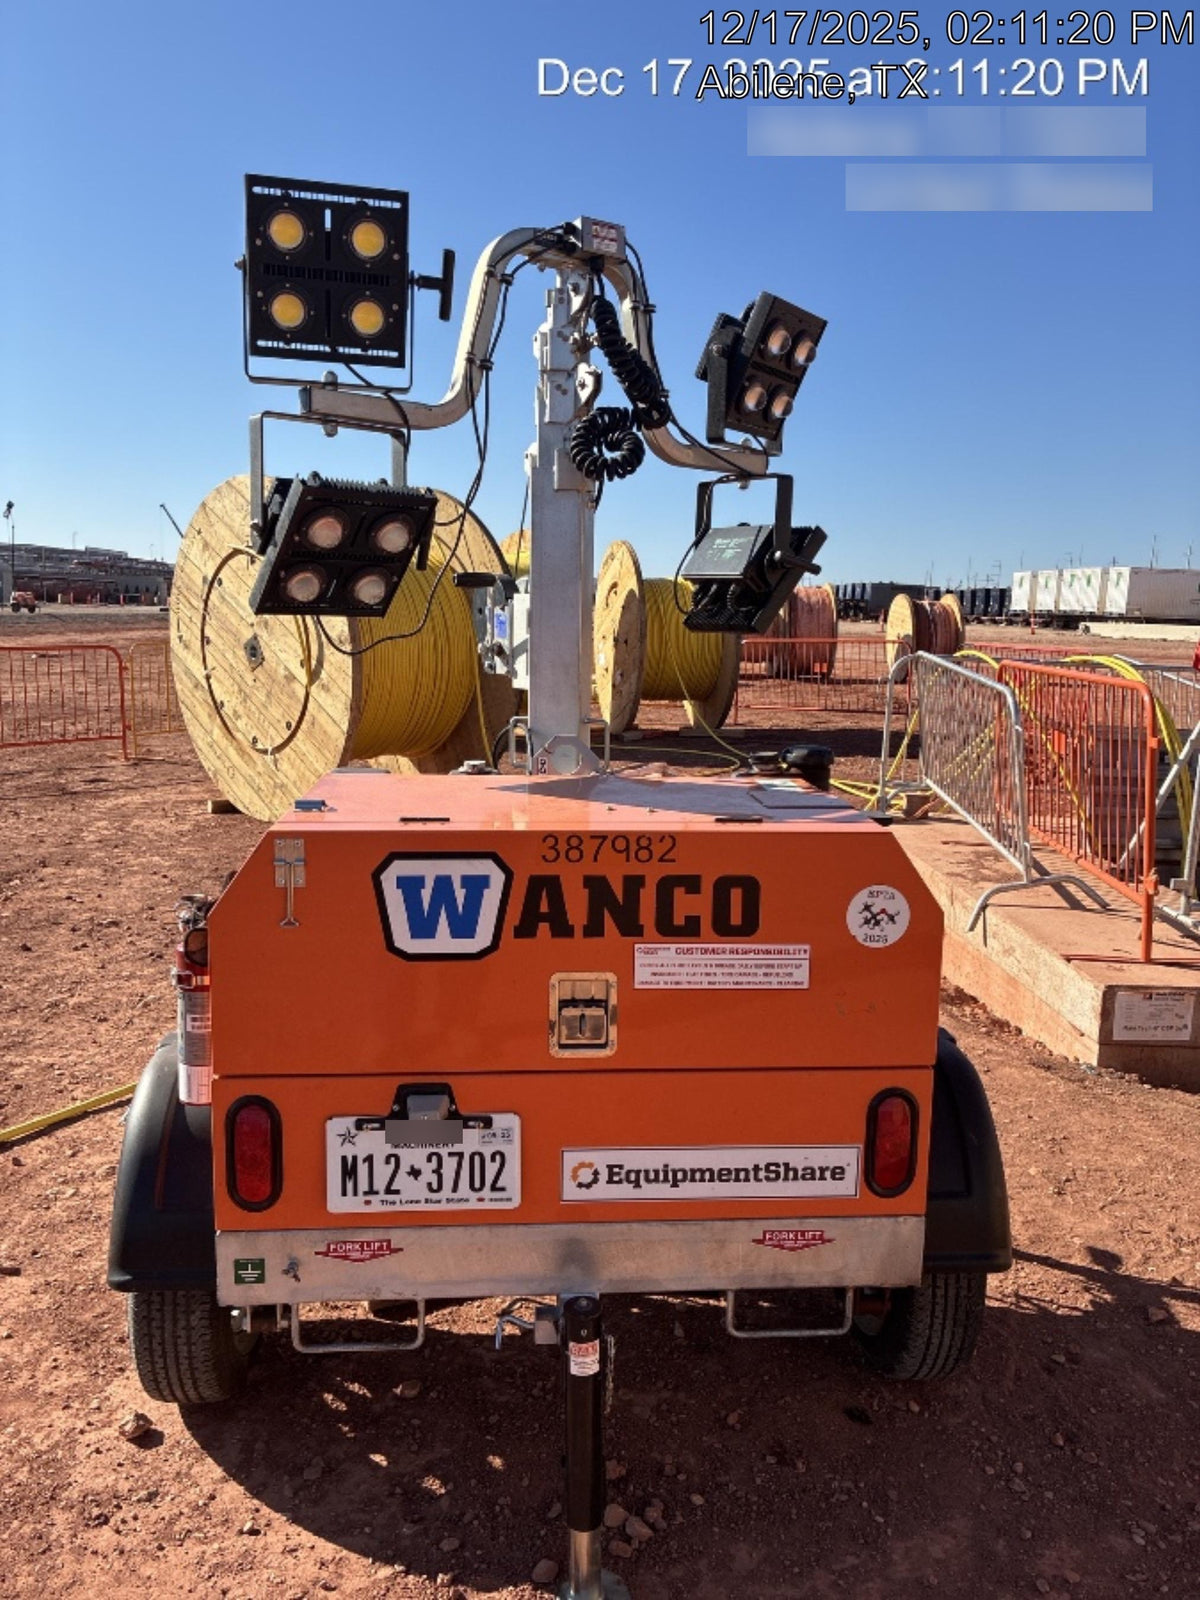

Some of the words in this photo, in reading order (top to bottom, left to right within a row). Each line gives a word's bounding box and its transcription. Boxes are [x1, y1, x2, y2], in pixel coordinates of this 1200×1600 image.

[540, 834, 678, 864] 387982
[675, 947, 727, 956] CUSTOMER
[425, 1150, 508, 1194] 3702
[605, 1161, 847, 1189] EquipmentShare
